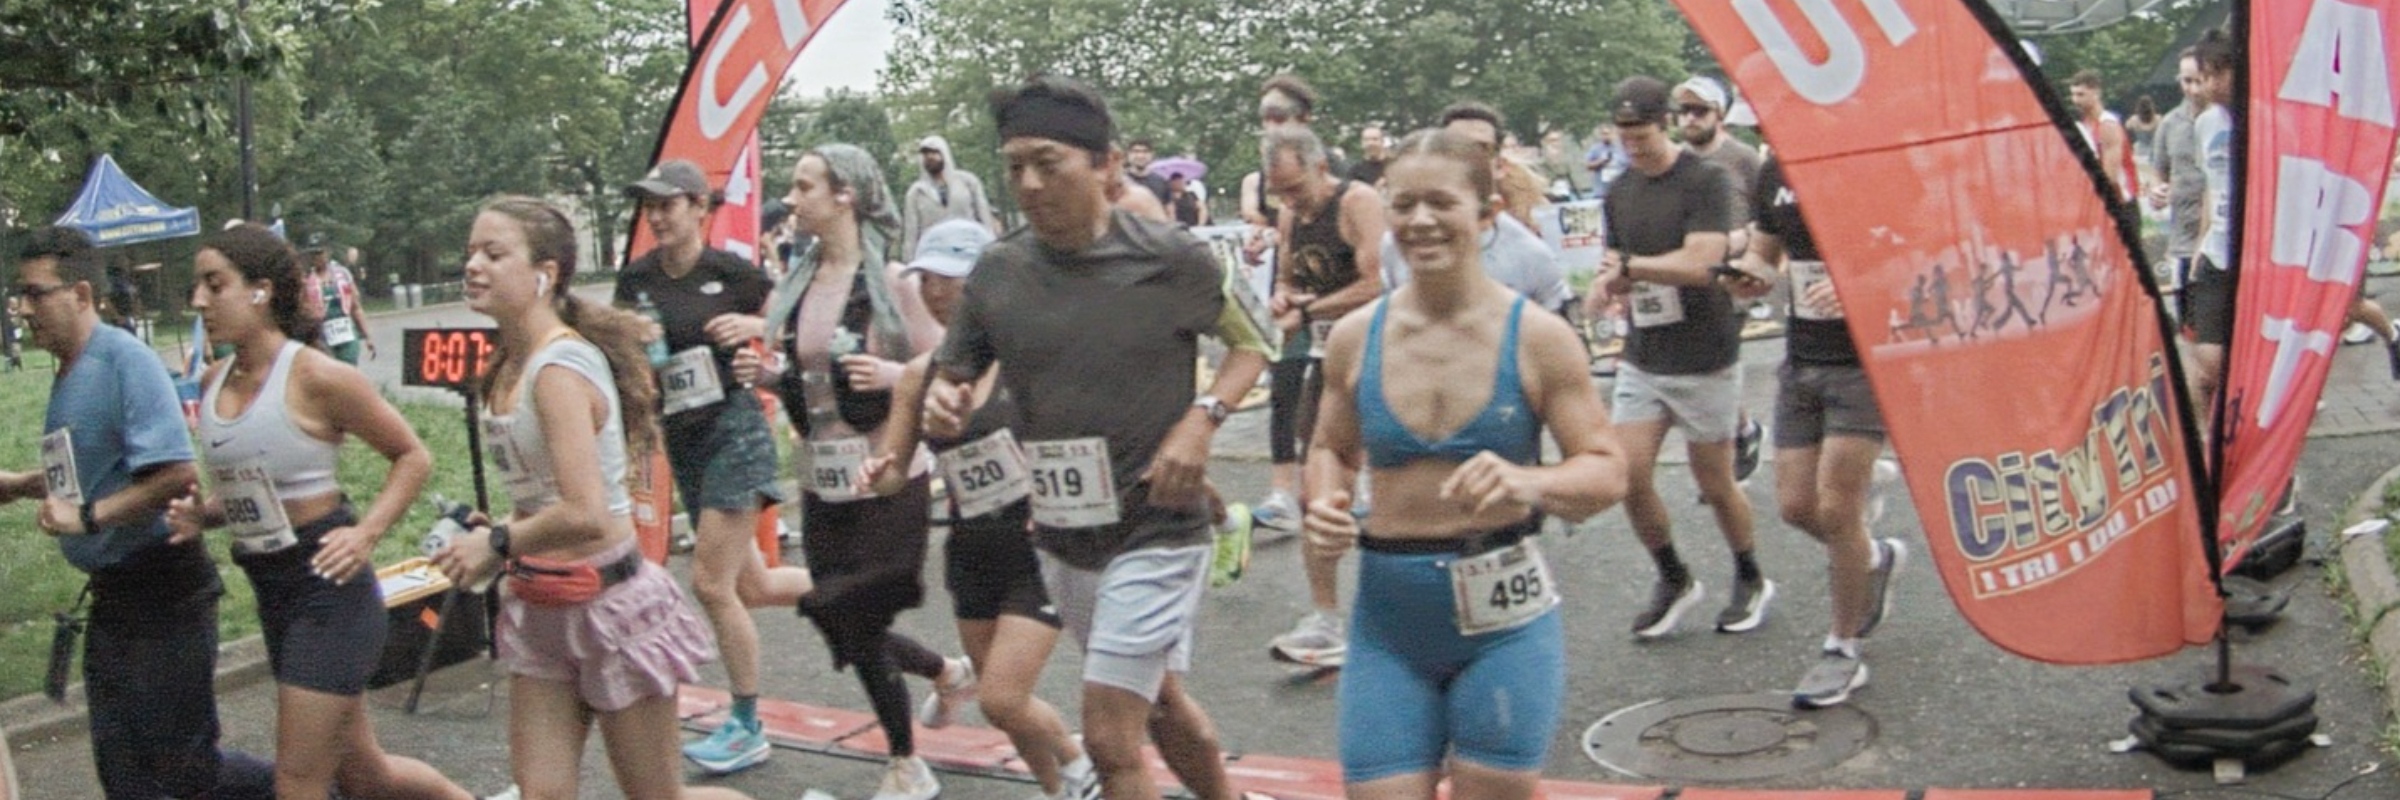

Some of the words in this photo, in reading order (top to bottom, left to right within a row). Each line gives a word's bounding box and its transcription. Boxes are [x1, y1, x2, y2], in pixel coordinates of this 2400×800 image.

[959, 459, 1005, 492] 520
[1031, 467, 1082, 498] 519
[1999, 551, 2058, 588] TRI
[1489, 567, 1542, 610] 495
